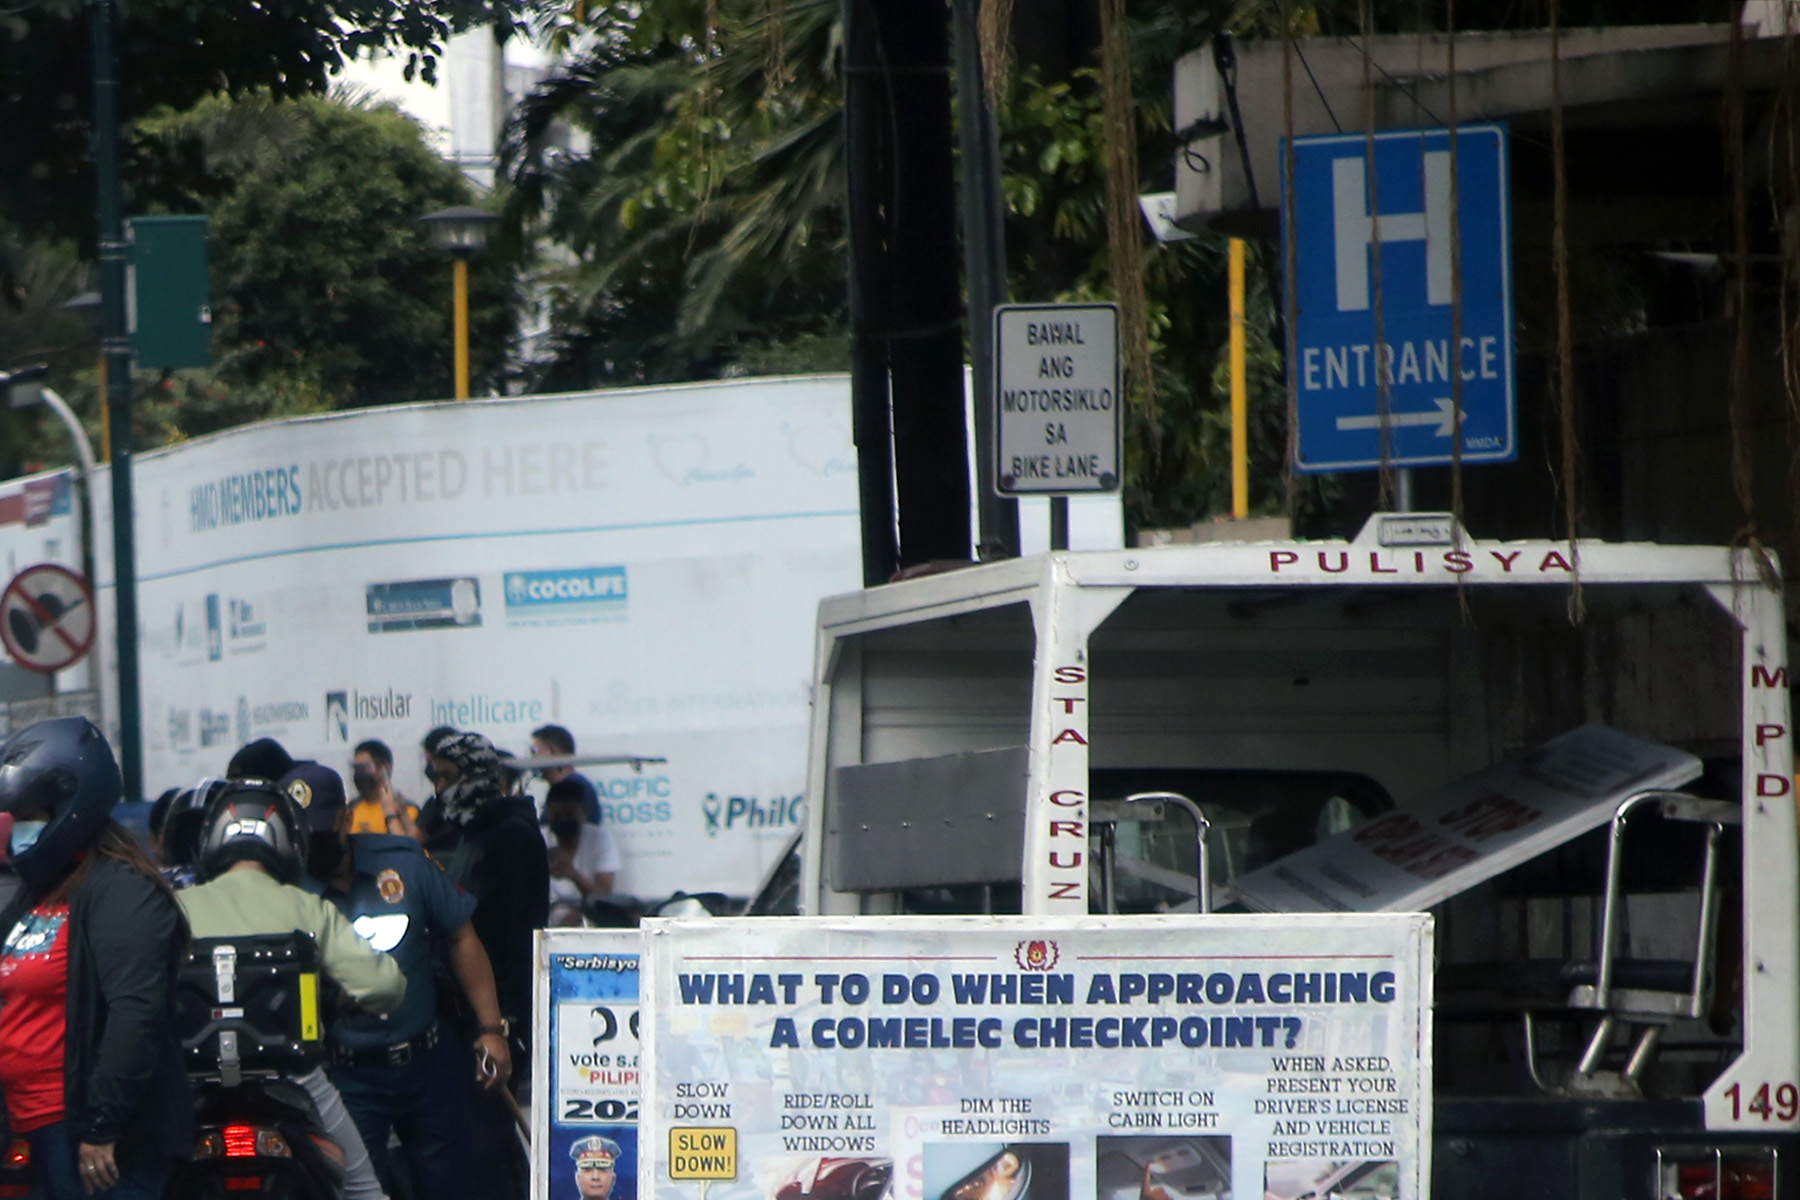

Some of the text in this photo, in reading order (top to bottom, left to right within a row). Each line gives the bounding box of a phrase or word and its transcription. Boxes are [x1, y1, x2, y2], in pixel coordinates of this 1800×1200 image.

[1333, 150, 1455, 312] H
[1027, 323, 1084, 345] BAWAL
[1038, 356, 1074, 378] ANG
[1303, 336, 1498, 391] ENTRANCE
[1004, 388, 1112, 413] MOTORSIKLO
[1045, 423, 1067, 445] SA
[1012, 455, 1099, 478] BIKE LANE
[221, 465, 301, 527] MEMBERS
[308, 449, 468, 512] ACCEPTED
[484, 441, 609, 496] HERE
[1269, 550, 1573, 574] PULISYA
[529, 575, 625, 599] COCOLIFE
[354, 689, 412, 720] Insular
[431, 696, 542, 725] Intellicare
[678, 971, 1396, 1005] WHAT TO DO WHEN APPROACHING
[769, 1016, 1302, 1049] A COMELEC CHECKPOINT?
[570, 1054, 610, 1067] vote
[1271, 1056, 1393, 1072] WHEN ASKED,
[676, 1083, 729, 1097] SLOW
[1267, 1078, 1396, 1093] PRESENT YOUR
[784, 1094, 873, 1109] RIDE/ROLL
[960, 1098, 1031, 1113] DIM THE
[1113, 1091, 1214, 1106] SWITCH ON
[1255, 1099, 1408, 1114] DRIVER'S LICENSE
[1723, 1082, 1799, 1122] 149
[674, 1104, 731, 1118] DOWN
[781, 1115, 876, 1130] DOWN ALL
[941, 1119, 1050, 1134] HEADLIGHTS
[1108, 1112, 1219, 1128] CABIN LIGHT
[1273, 1120, 1391, 1135] AND VEHICLE
[679, 1135, 726, 1150] SLOW
[783, 1136, 875, 1151] WINDOWS
[1268, 1142, 1394, 1157] REGISTRATION
[675, 1157, 731, 1172] DOWN!
